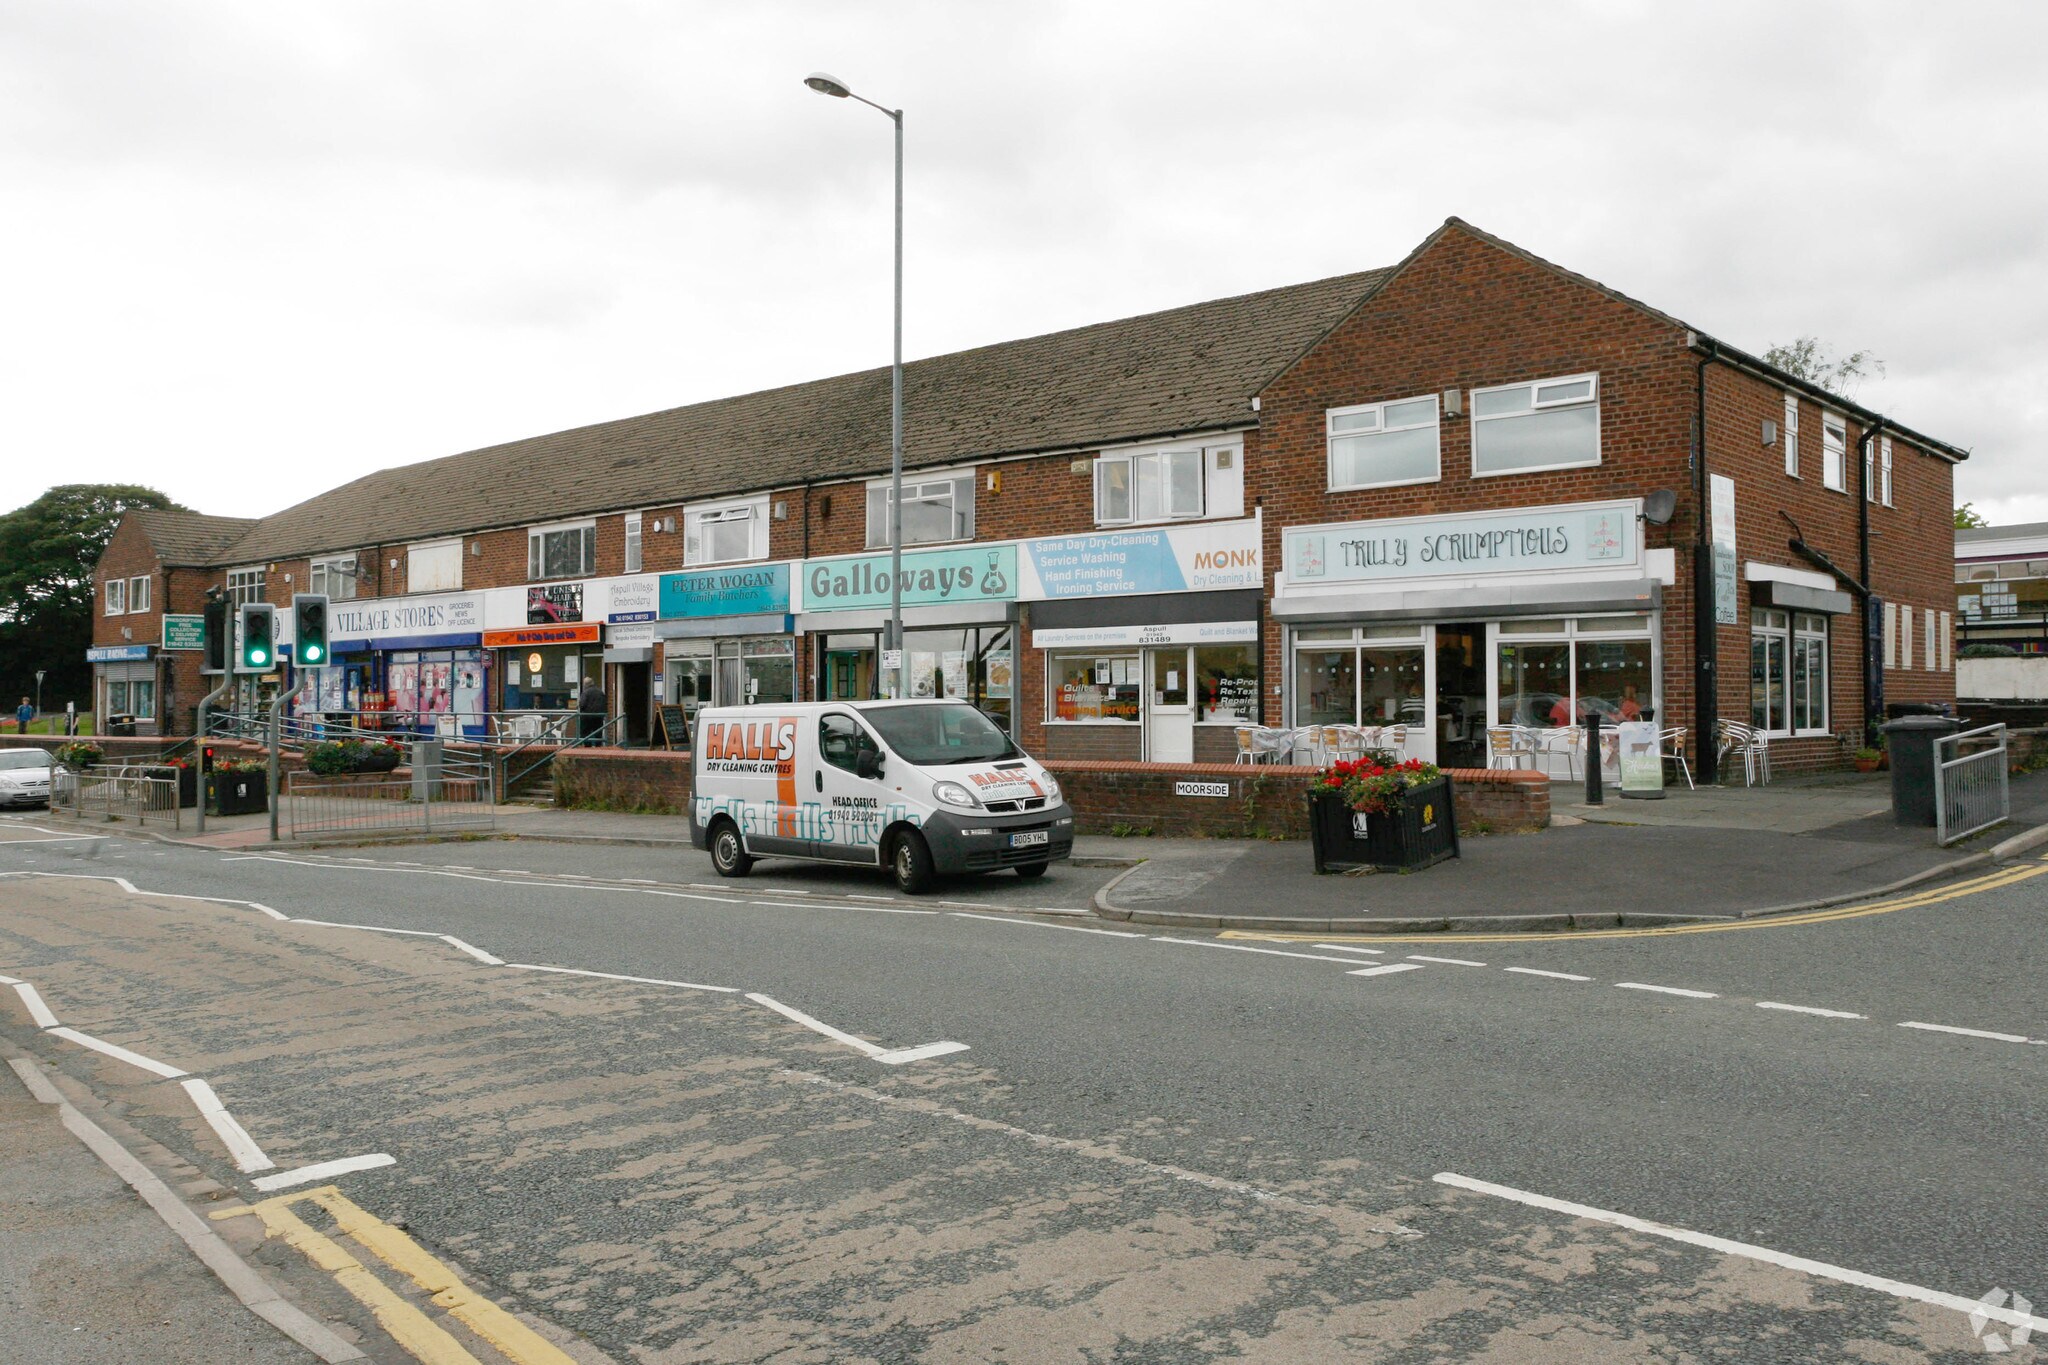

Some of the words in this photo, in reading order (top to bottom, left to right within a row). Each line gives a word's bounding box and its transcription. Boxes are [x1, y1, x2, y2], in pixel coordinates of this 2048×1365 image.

[1036, 542, 1062, 552] Same
[1066, 540, 1086, 551] Day
[1089, 534, 1159, 549] Dry-Cleaning
[1421, 526, 1568, 563] SCRUMPTIOUS
[1041, 557, 1077, 567] Service
[1081, 552, 1126, 564] Washing
[1194, 549, 1257, 569] MONK
[811, 562, 974, 598] Galloways
[1045, 570, 1072, 581] Hand
[1075, 567, 1123, 579] Finishing
[1193, 575, 1207, 587] Dry
[1209, 572, 1244, 585] Cleaning
[1246, 571, 1252, 582] &
[632, 582, 654, 594] Village
[672, 577, 715, 592] PETER
[720, 572, 774, 588] WOGAN
[1056, 582, 1092, 594] Ironing
[1096, 580, 1135, 592] Service
[554, 585, 582, 594] UNISEX
[554, 594, 572, 602] HAIR
[614, 596, 651, 607] Embroidery
[684, 592, 715, 604] Family
[718, 590, 759, 601] Butchers
[449, 602, 474, 610] GROCERIES
[553, 601, 581, 609] BEAUTY
[337, 610, 390, 633] VILLAGE
[395, 605, 444, 629] STORES
[455, 610, 468, 618] NEWS
[1715, 605, 1735, 624] Coffee
[1045, 634, 1064, 643] Laundry
[1103, 633, 1127, 641] premises
[1200, 628, 1213, 636] Quilt
[1226, 627, 1247, 635] Blanket
[1101, 704, 1137, 716] Service
[707, 722, 795, 761] HALLS
[706, 762, 721, 771] DRY
[722, 762, 758, 773] CLEANING
[760, 763, 791, 774] CENTRES
[968, 767, 1034, 787] HALLS
[1177, 784, 1227, 795] MOORSIDE
[832, 796, 851, 807] HEAD
[853, 797, 878, 809] OFFICE
[828, 809, 850, 821] 01942
[1032, 833, 1047, 842] YHL
